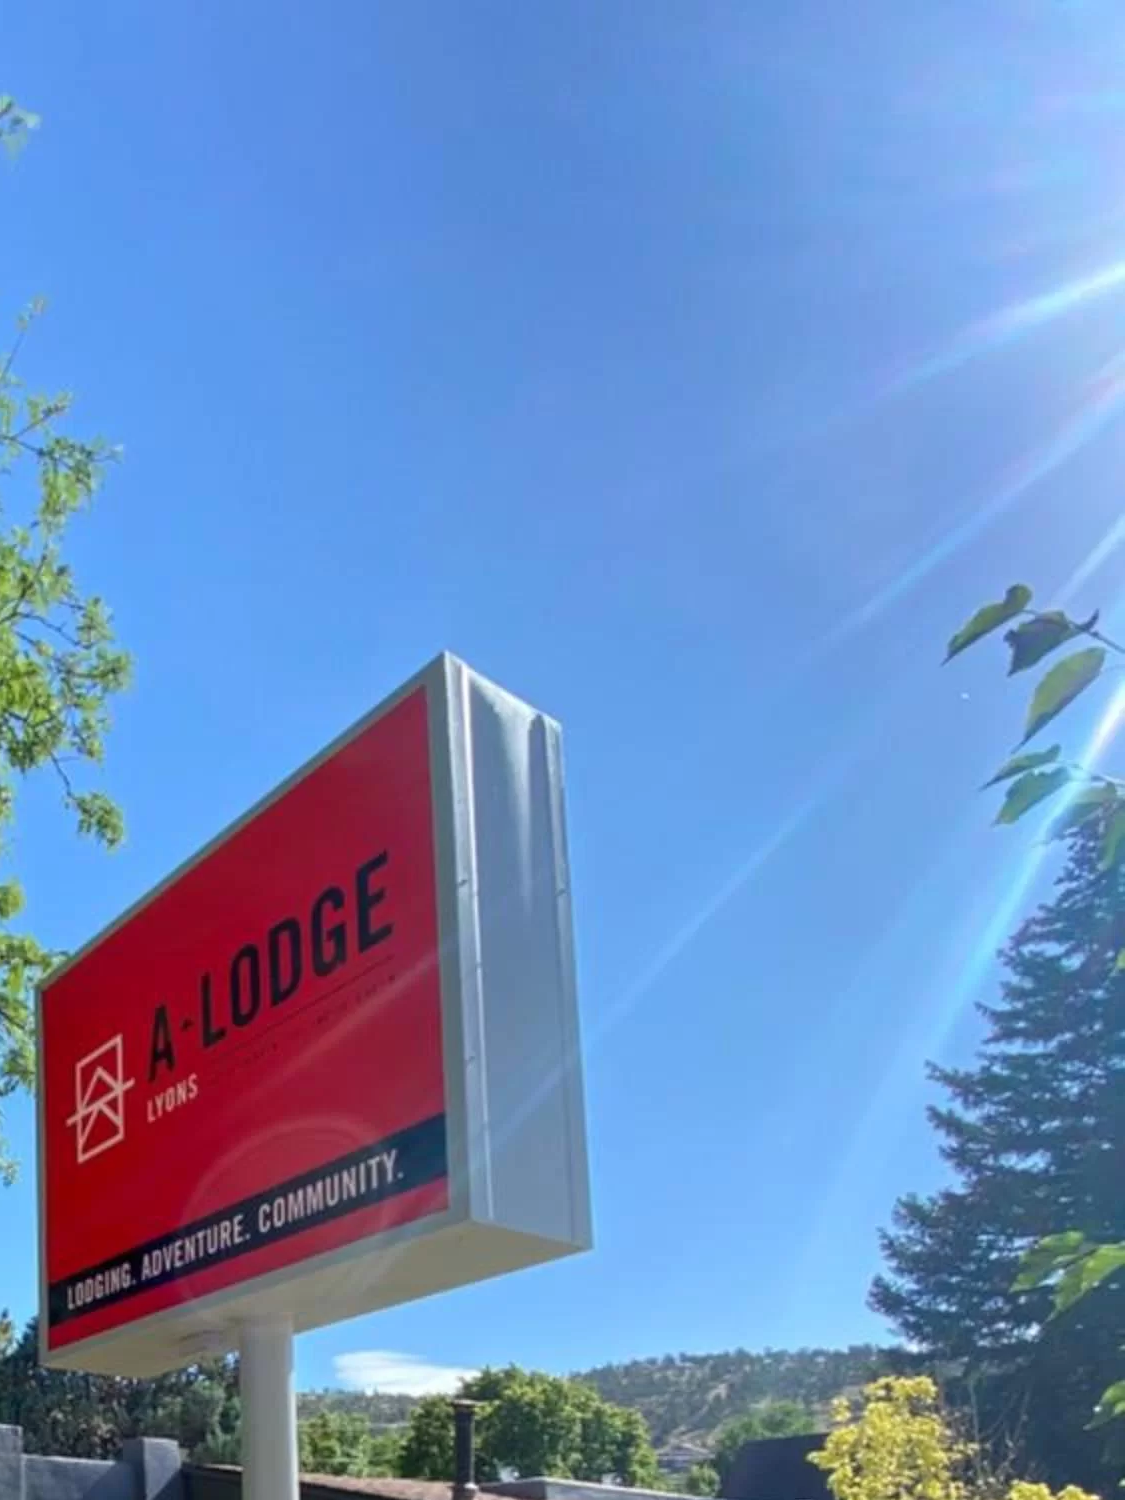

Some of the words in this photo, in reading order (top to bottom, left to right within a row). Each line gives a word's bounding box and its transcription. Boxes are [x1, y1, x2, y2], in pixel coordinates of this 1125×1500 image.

[147, 850, 395, 1084] A-LODGE
[146, 1073, 199, 1123] LYONS
[66, 1264, 136, 1311] LODGING.
[141, 1220, 251, 1279] ADVENTURE.
[257, 1148, 405, 1234] COMMUNITY.
